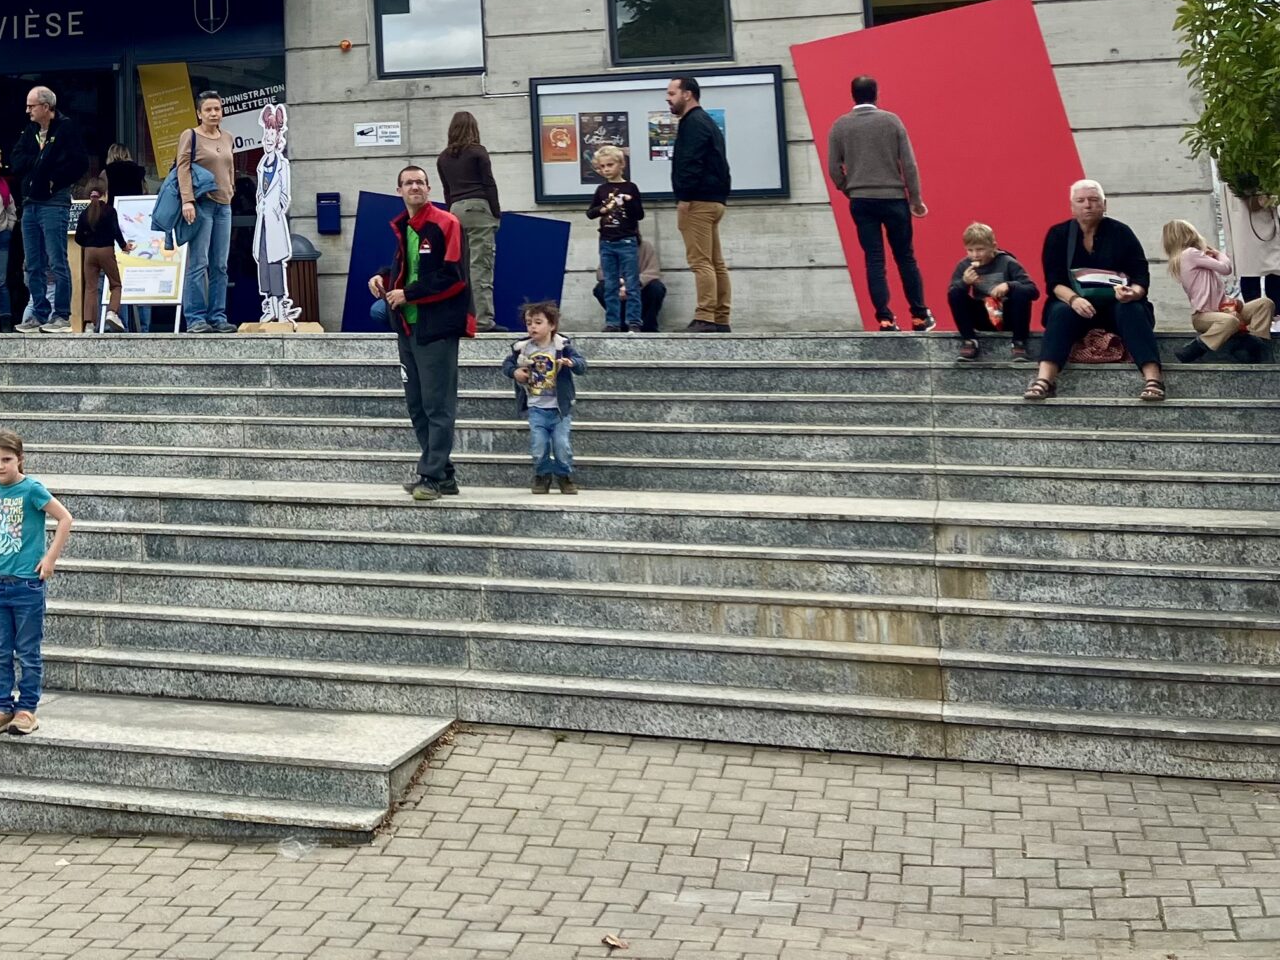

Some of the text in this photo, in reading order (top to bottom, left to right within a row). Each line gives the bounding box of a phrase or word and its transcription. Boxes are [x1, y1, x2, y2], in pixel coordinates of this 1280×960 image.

[221, 83, 285, 105] DMINISTRATION
[224, 95, 277, 115] BILLETTERIE
[232, 136, 255, 149] 0m
[9, 505, 23, 514] THE
[6, 514, 23, 523] SUN
